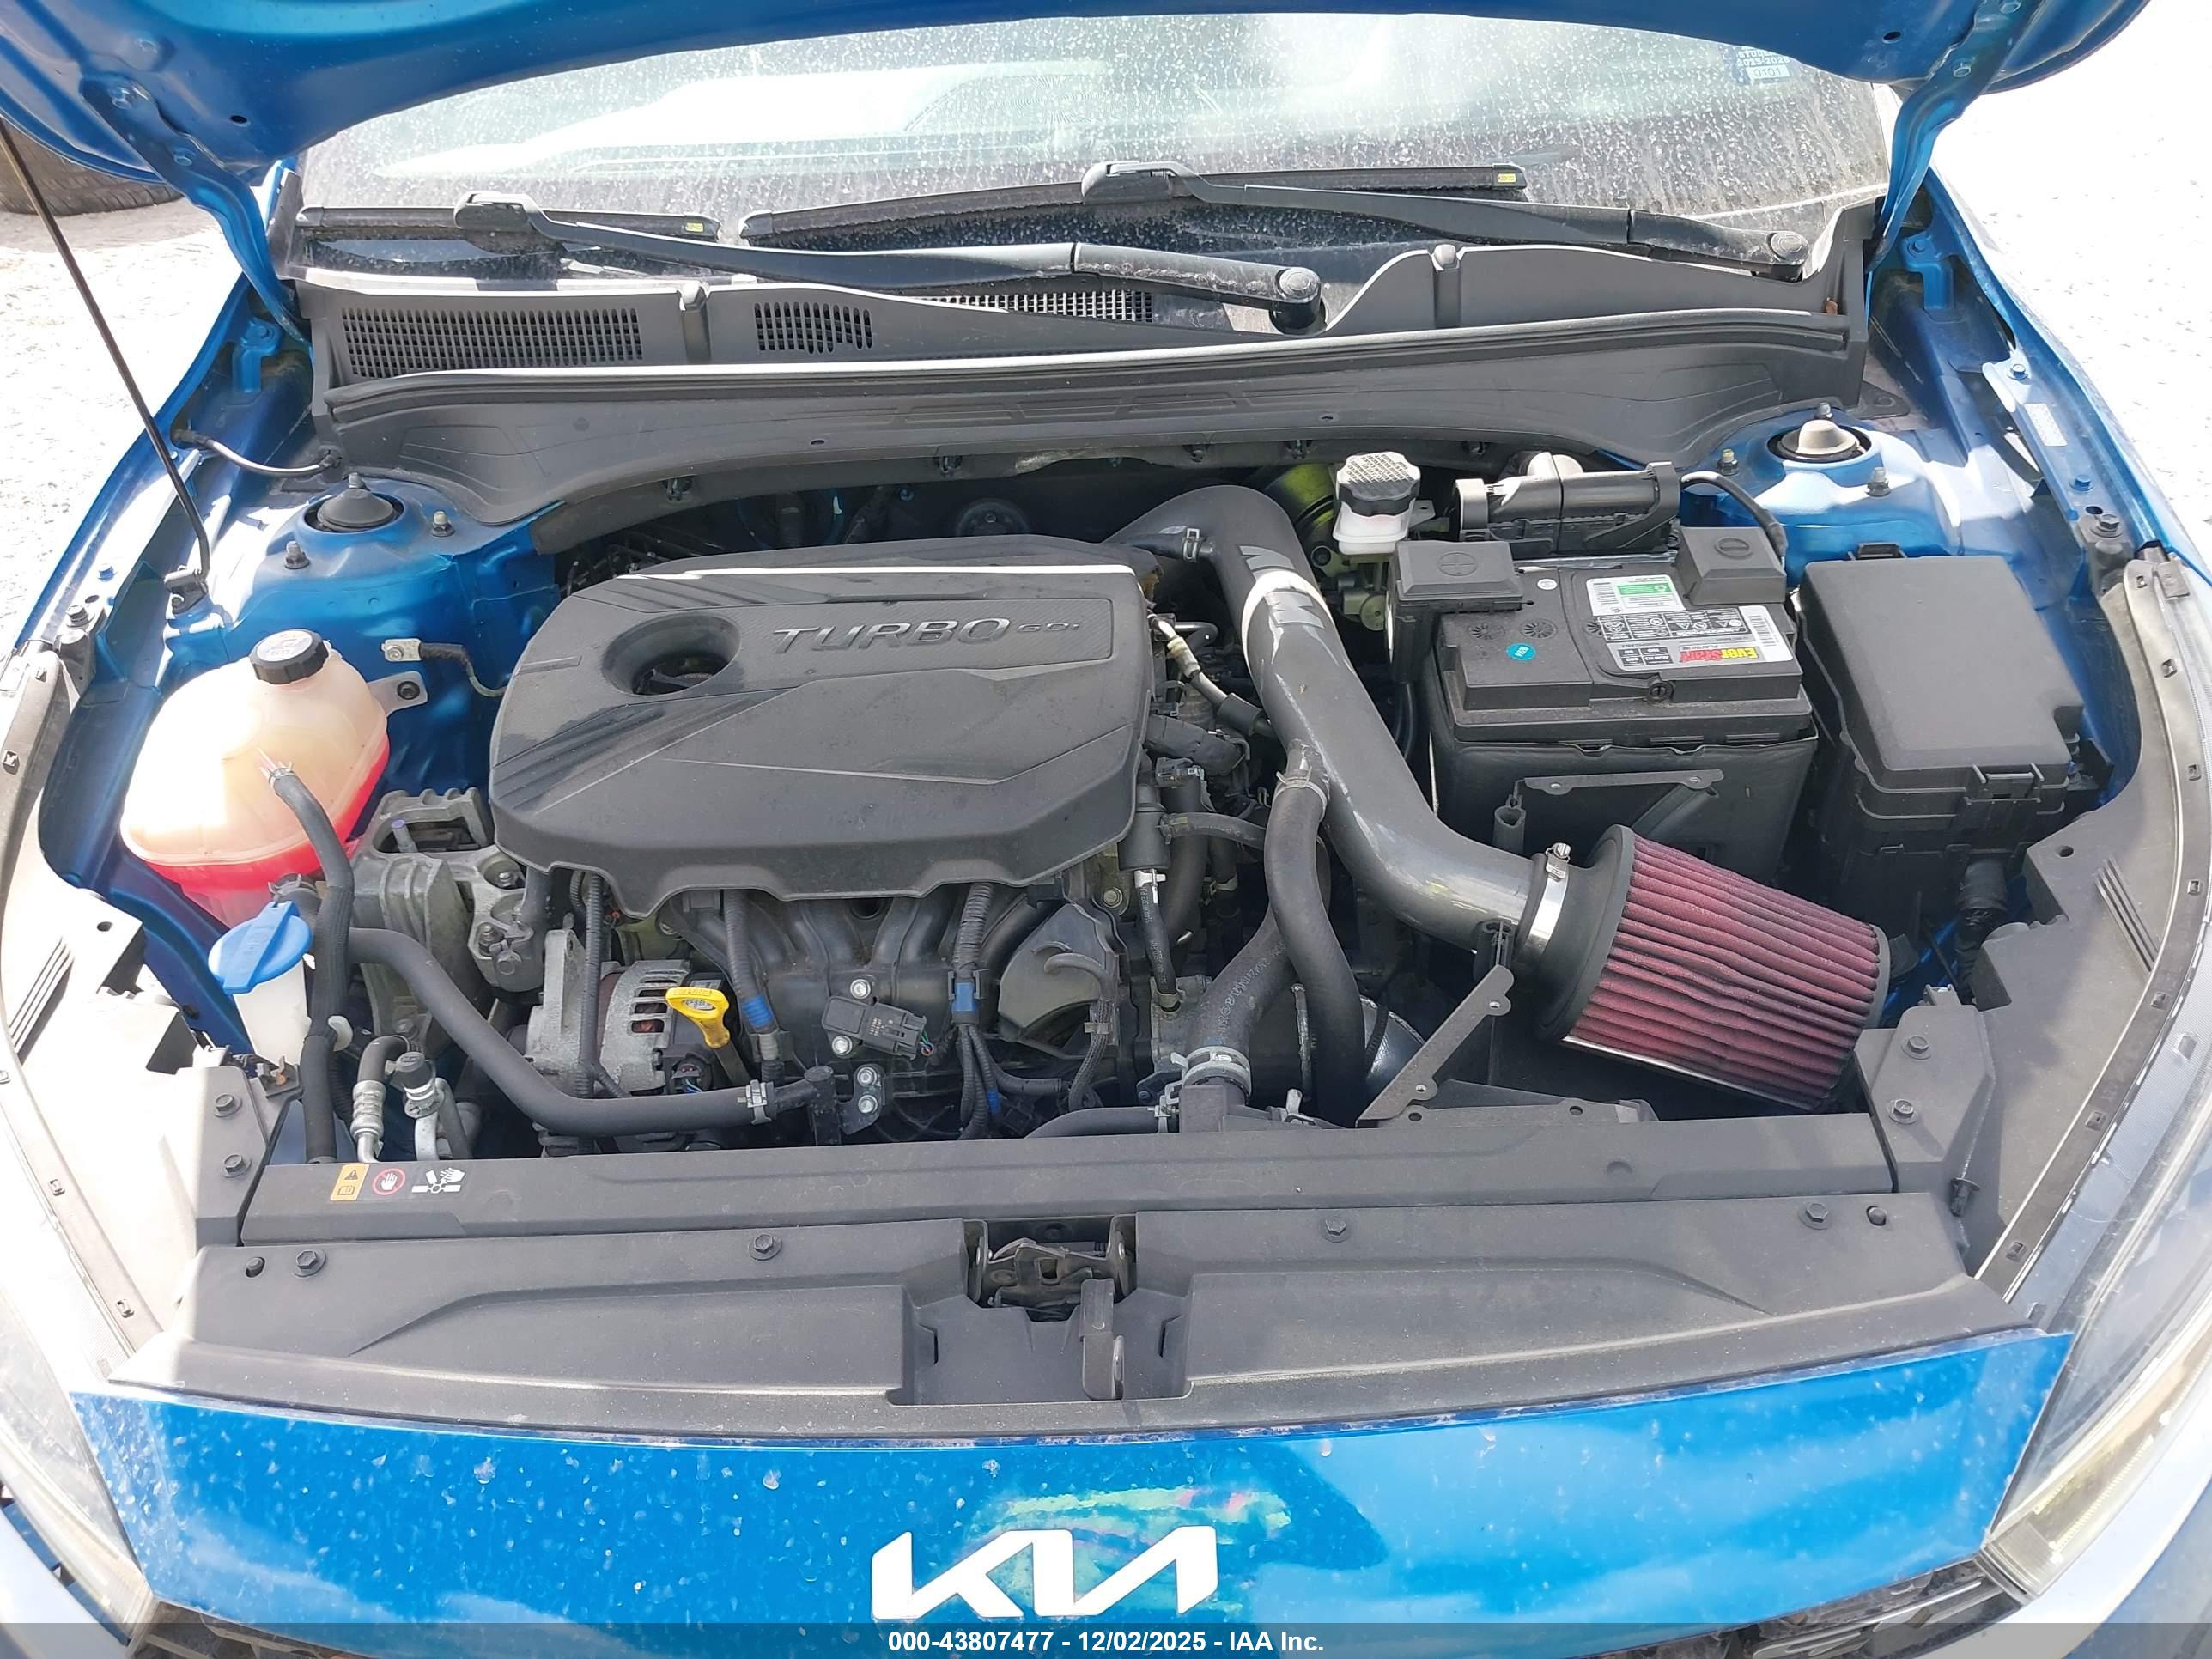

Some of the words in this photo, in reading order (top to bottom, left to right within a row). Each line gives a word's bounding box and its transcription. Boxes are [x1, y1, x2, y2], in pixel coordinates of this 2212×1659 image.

[1753, 67, 1781, 77] 0101
[772, 618, 1011, 653] TURBO
[1679, 646, 1759, 662] EverStart
[872, 1525, 1218, 1620] KIA
